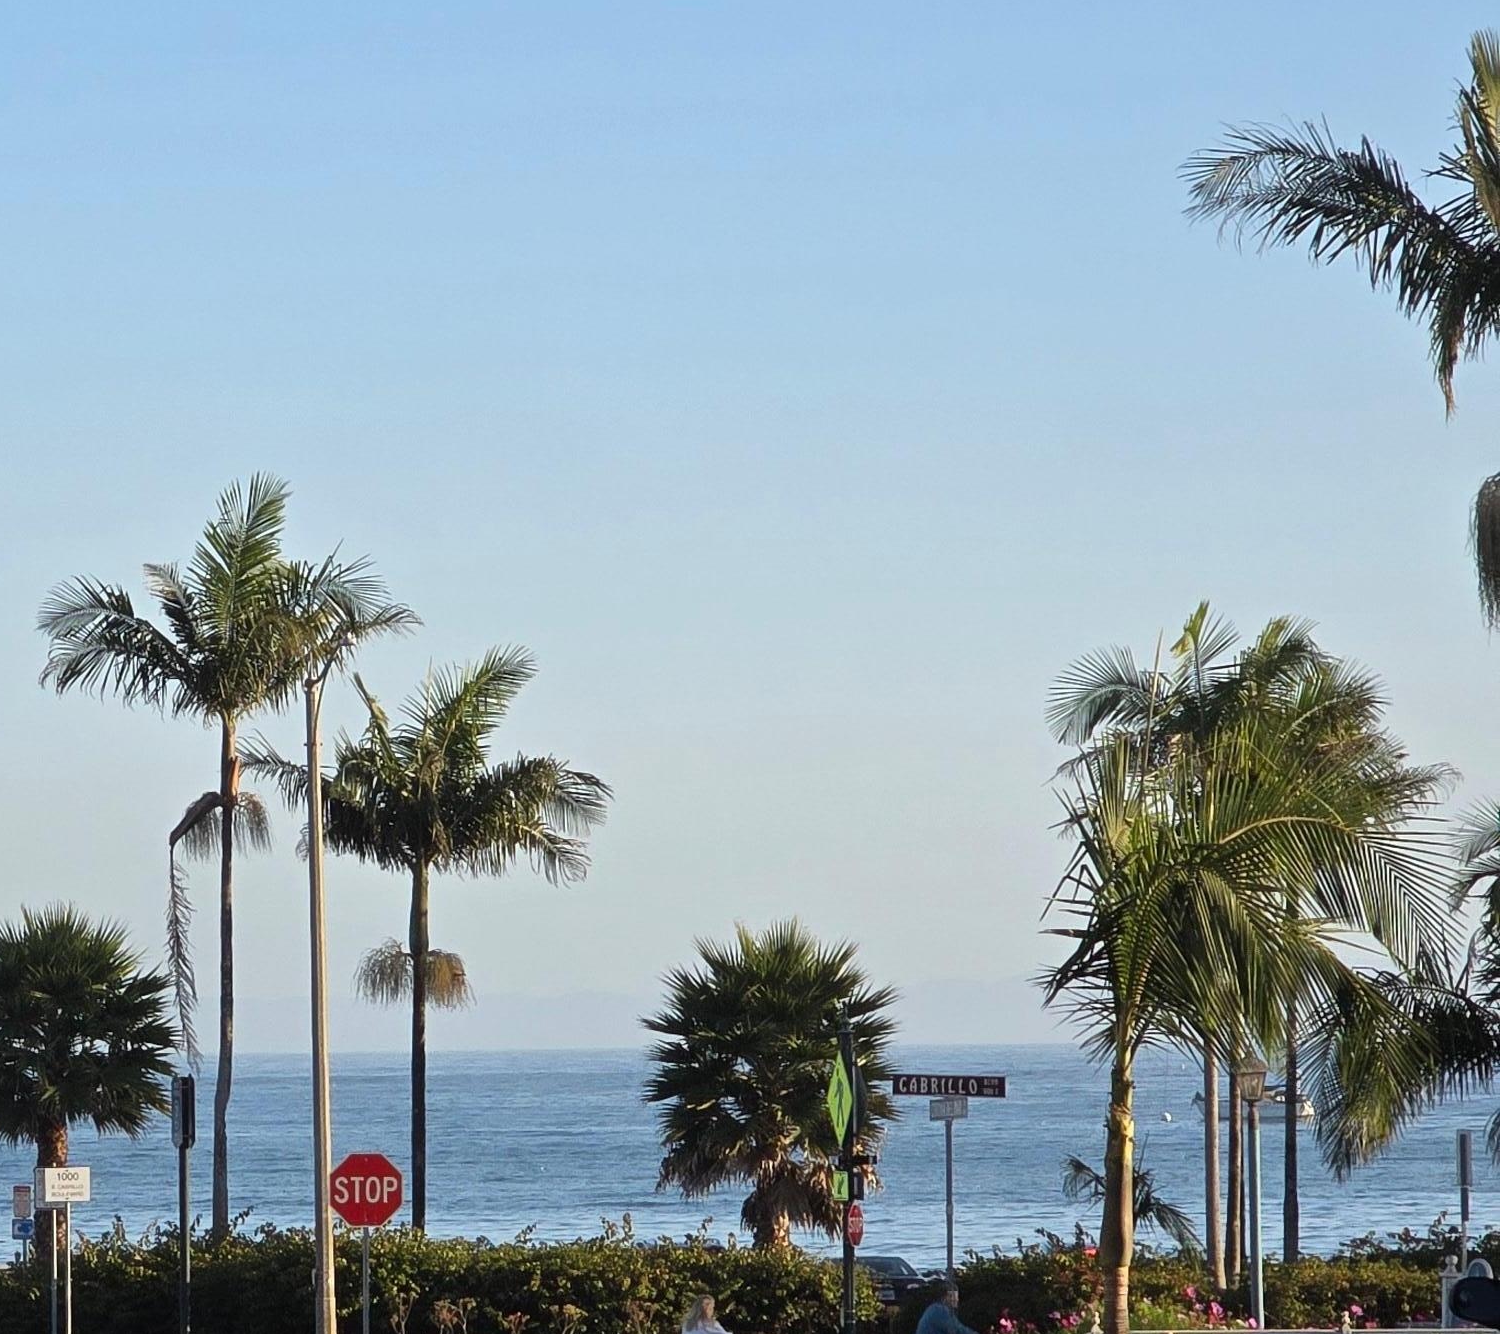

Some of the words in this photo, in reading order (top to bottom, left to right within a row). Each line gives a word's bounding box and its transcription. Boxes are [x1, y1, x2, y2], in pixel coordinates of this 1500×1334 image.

[899, 1076, 978, 1095] CABRILLO
[56, 1171, 80, 1182] 1000
[333, 1175, 399, 1204] STOP
[848, 1216, 864, 1234] STOP
